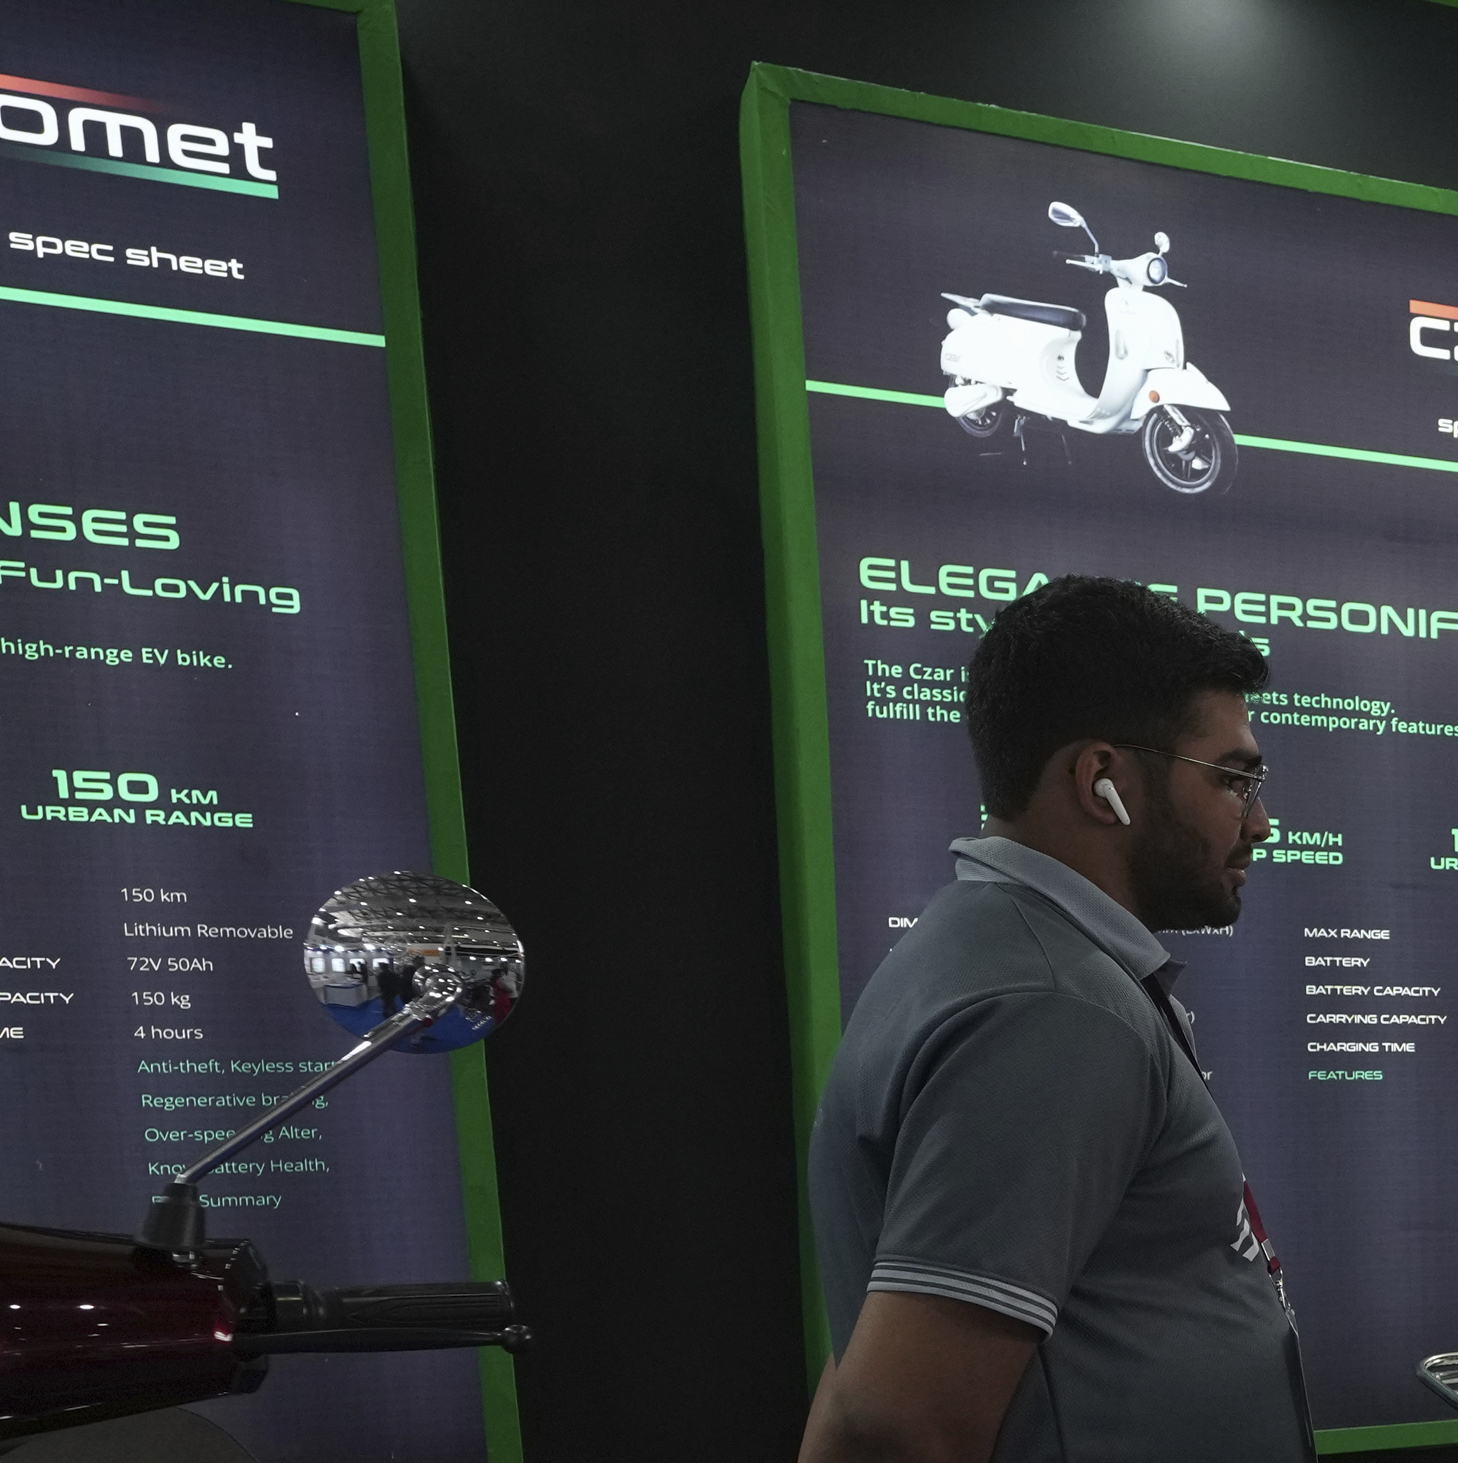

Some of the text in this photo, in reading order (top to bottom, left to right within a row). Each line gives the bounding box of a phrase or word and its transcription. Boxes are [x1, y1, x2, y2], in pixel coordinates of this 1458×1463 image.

[8, 231, 245, 280] spec sheet
[0, 559, 301, 614] Fun-Loving
[860, 599, 916, 628] Its
[0, 637, 233, 669] high-range EV bike.
[864, 660, 954, 682] The Czar
[866, 700, 961, 723] fulfill the
[1293, 692, 1396, 717] technology.
[1260, 711, 1387, 736] contemporary
[52, 769, 219, 805] 150 KM
[20, 804, 254, 828] URBAN RANGE
[1287, 830, 1343, 848] KM/H
[1272, 849, 1344, 865] SPEED
[120, 887, 187, 903] 150 km
[123, 922, 294, 939] Lithium Removable
[1304, 927, 1391, 940] MAX RANGE
[127, 957, 214, 972] 72V 50Ah
[1304, 956, 1371, 968] BATTERY
[1305, 984, 1441, 997] BATTERY CAPACITY
[131, 991, 192, 1010] 150 kg
[1306, 1013, 1447, 1025] CARRYING CAPACITY
[133, 1025, 204, 1040] 4 hours
[1307, 1042, 1416, 1053] CHARGING TIME
[138, 1060, 294, 1077] Anti-theft, Keyless
[1308, 1070, 1384, 1081] FEATURES
[142, 1093, 255, 1111] Regenerative
[145, 1125, 322, 1144] Over-speeg Alter,
[271, 1158, 330, 1174] Health,
[199, 1194, 282, 1209] Summary
